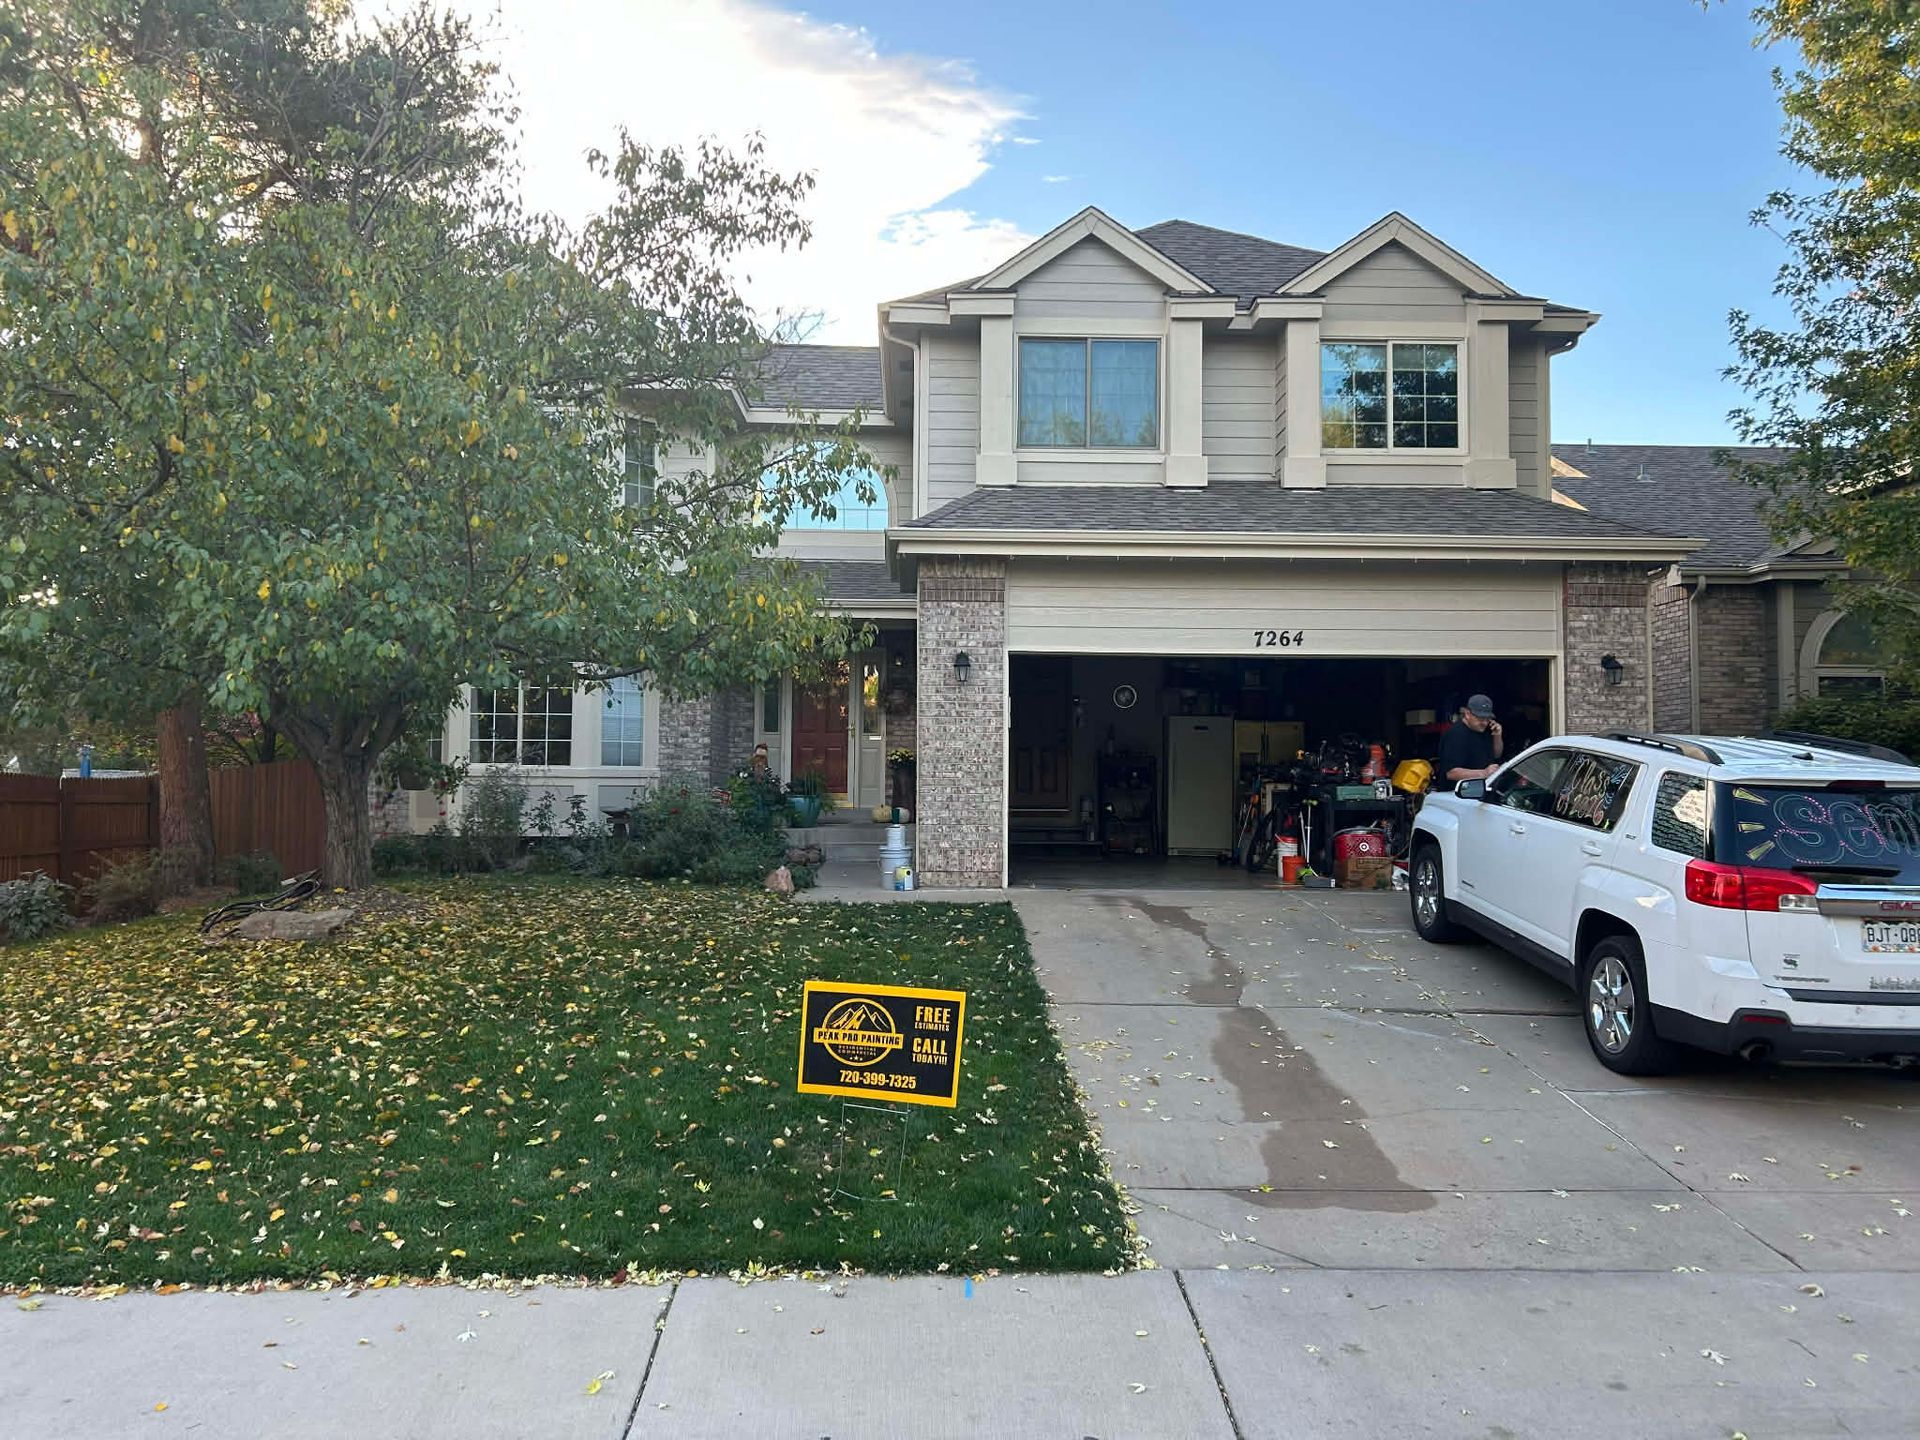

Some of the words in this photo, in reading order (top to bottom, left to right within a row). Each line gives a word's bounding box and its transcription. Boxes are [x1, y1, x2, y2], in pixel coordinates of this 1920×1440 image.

[1254, 630, 1304, 647] 7264
[915, 1005, 951, 1024] FREE
[914, 1021, 950, 1032] ESTIMATES
[817, 1031, 839, 1041] PEAK
[842, 1032, 858, 1042] PRO
[861, 1034, 900, 1046] PAINTING
[912, 1037, 948, 1055] CALL
[912, 1053, 948, 1066] TODAY!!!
[840, 1069, 917, 1089] 720-399-7325
